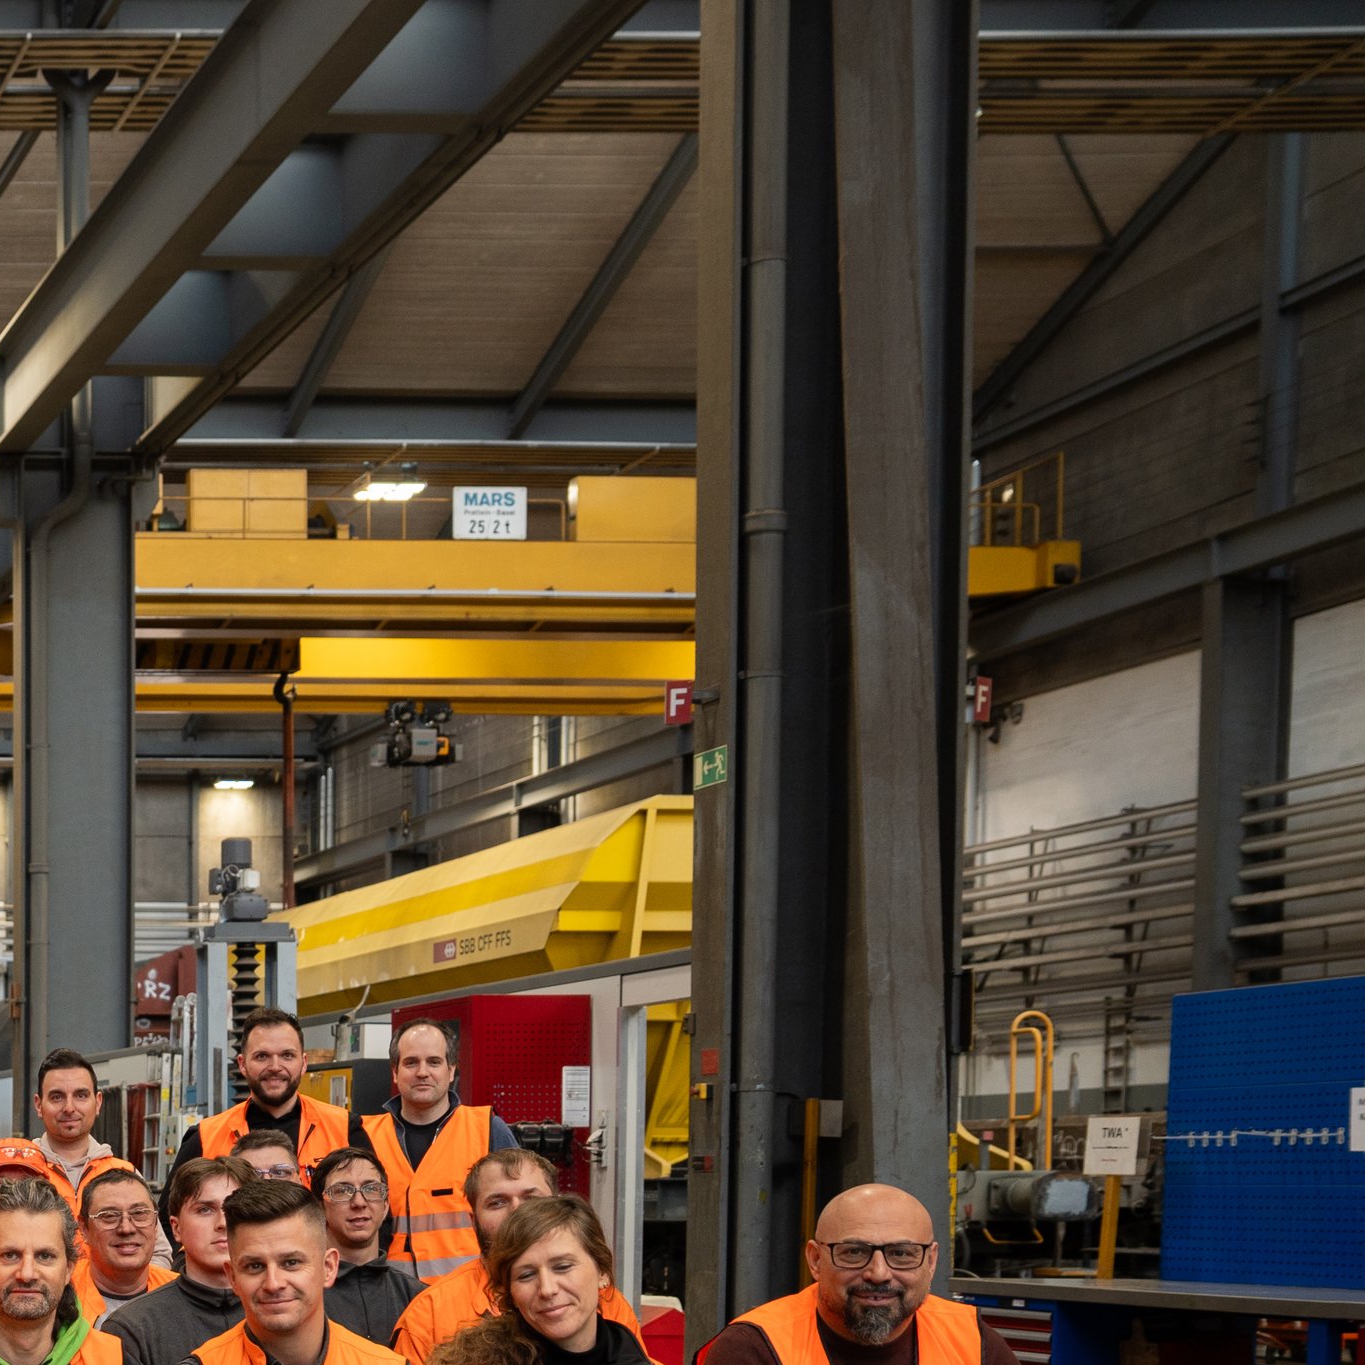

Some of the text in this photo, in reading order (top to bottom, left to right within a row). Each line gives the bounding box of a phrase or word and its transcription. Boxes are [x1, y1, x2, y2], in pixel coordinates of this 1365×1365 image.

[464, 492, 516, 506] MARS
[670, 687, 688, 717] F
[976, 684, 989, 713] F
[459, 929, 511, 955] SBB CFF FFS
